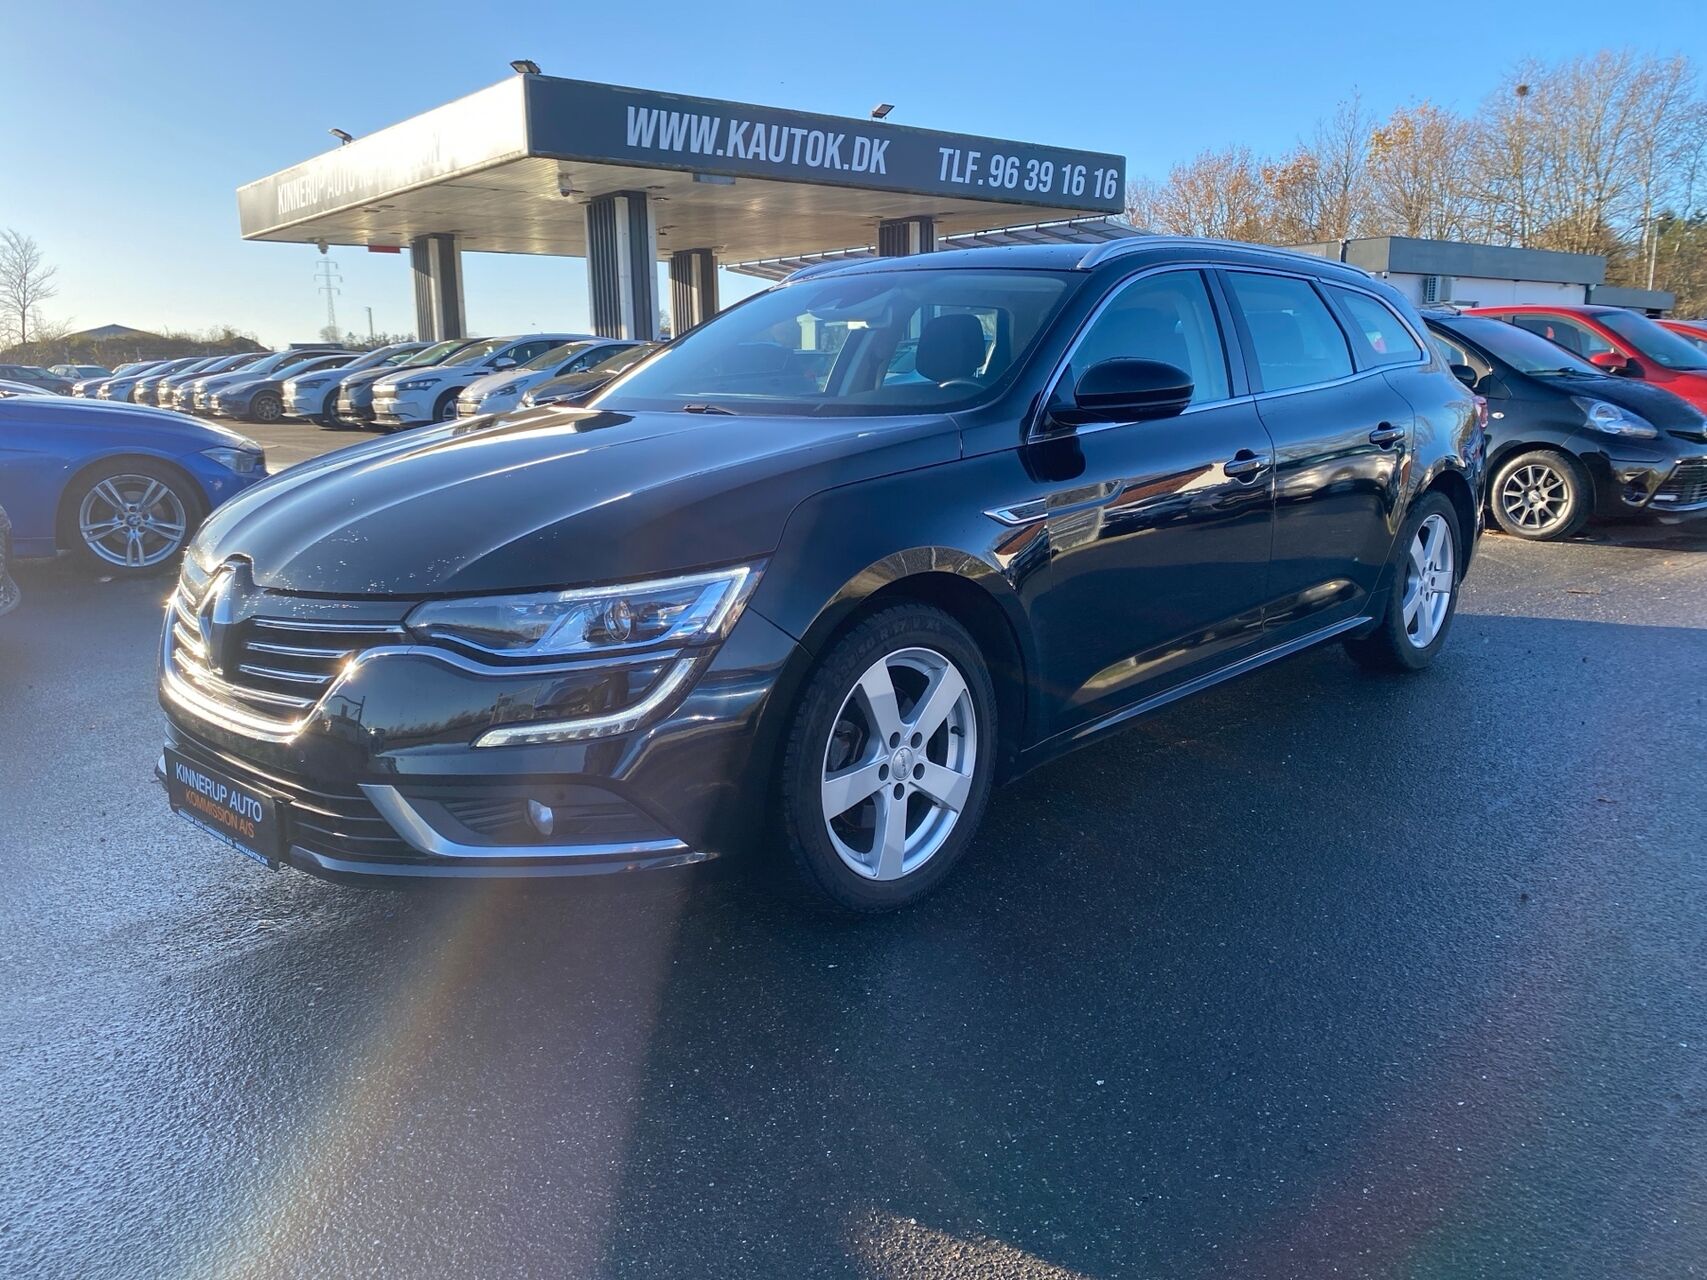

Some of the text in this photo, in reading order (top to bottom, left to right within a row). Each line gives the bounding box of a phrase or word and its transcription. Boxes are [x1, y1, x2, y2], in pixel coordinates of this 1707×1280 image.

[627, 106, 890, 175] WWW.KAUTOK.DK
[277, 174, 325, 216] KINNERUP
[939, 146, 1118, 200] TLF. 96 39 16 16
[175, 761, 262, 823] KINNERUP AUTO
[185, 789, 238, 829] KOMMISSION
[239, 821, 255, 839] A/S
